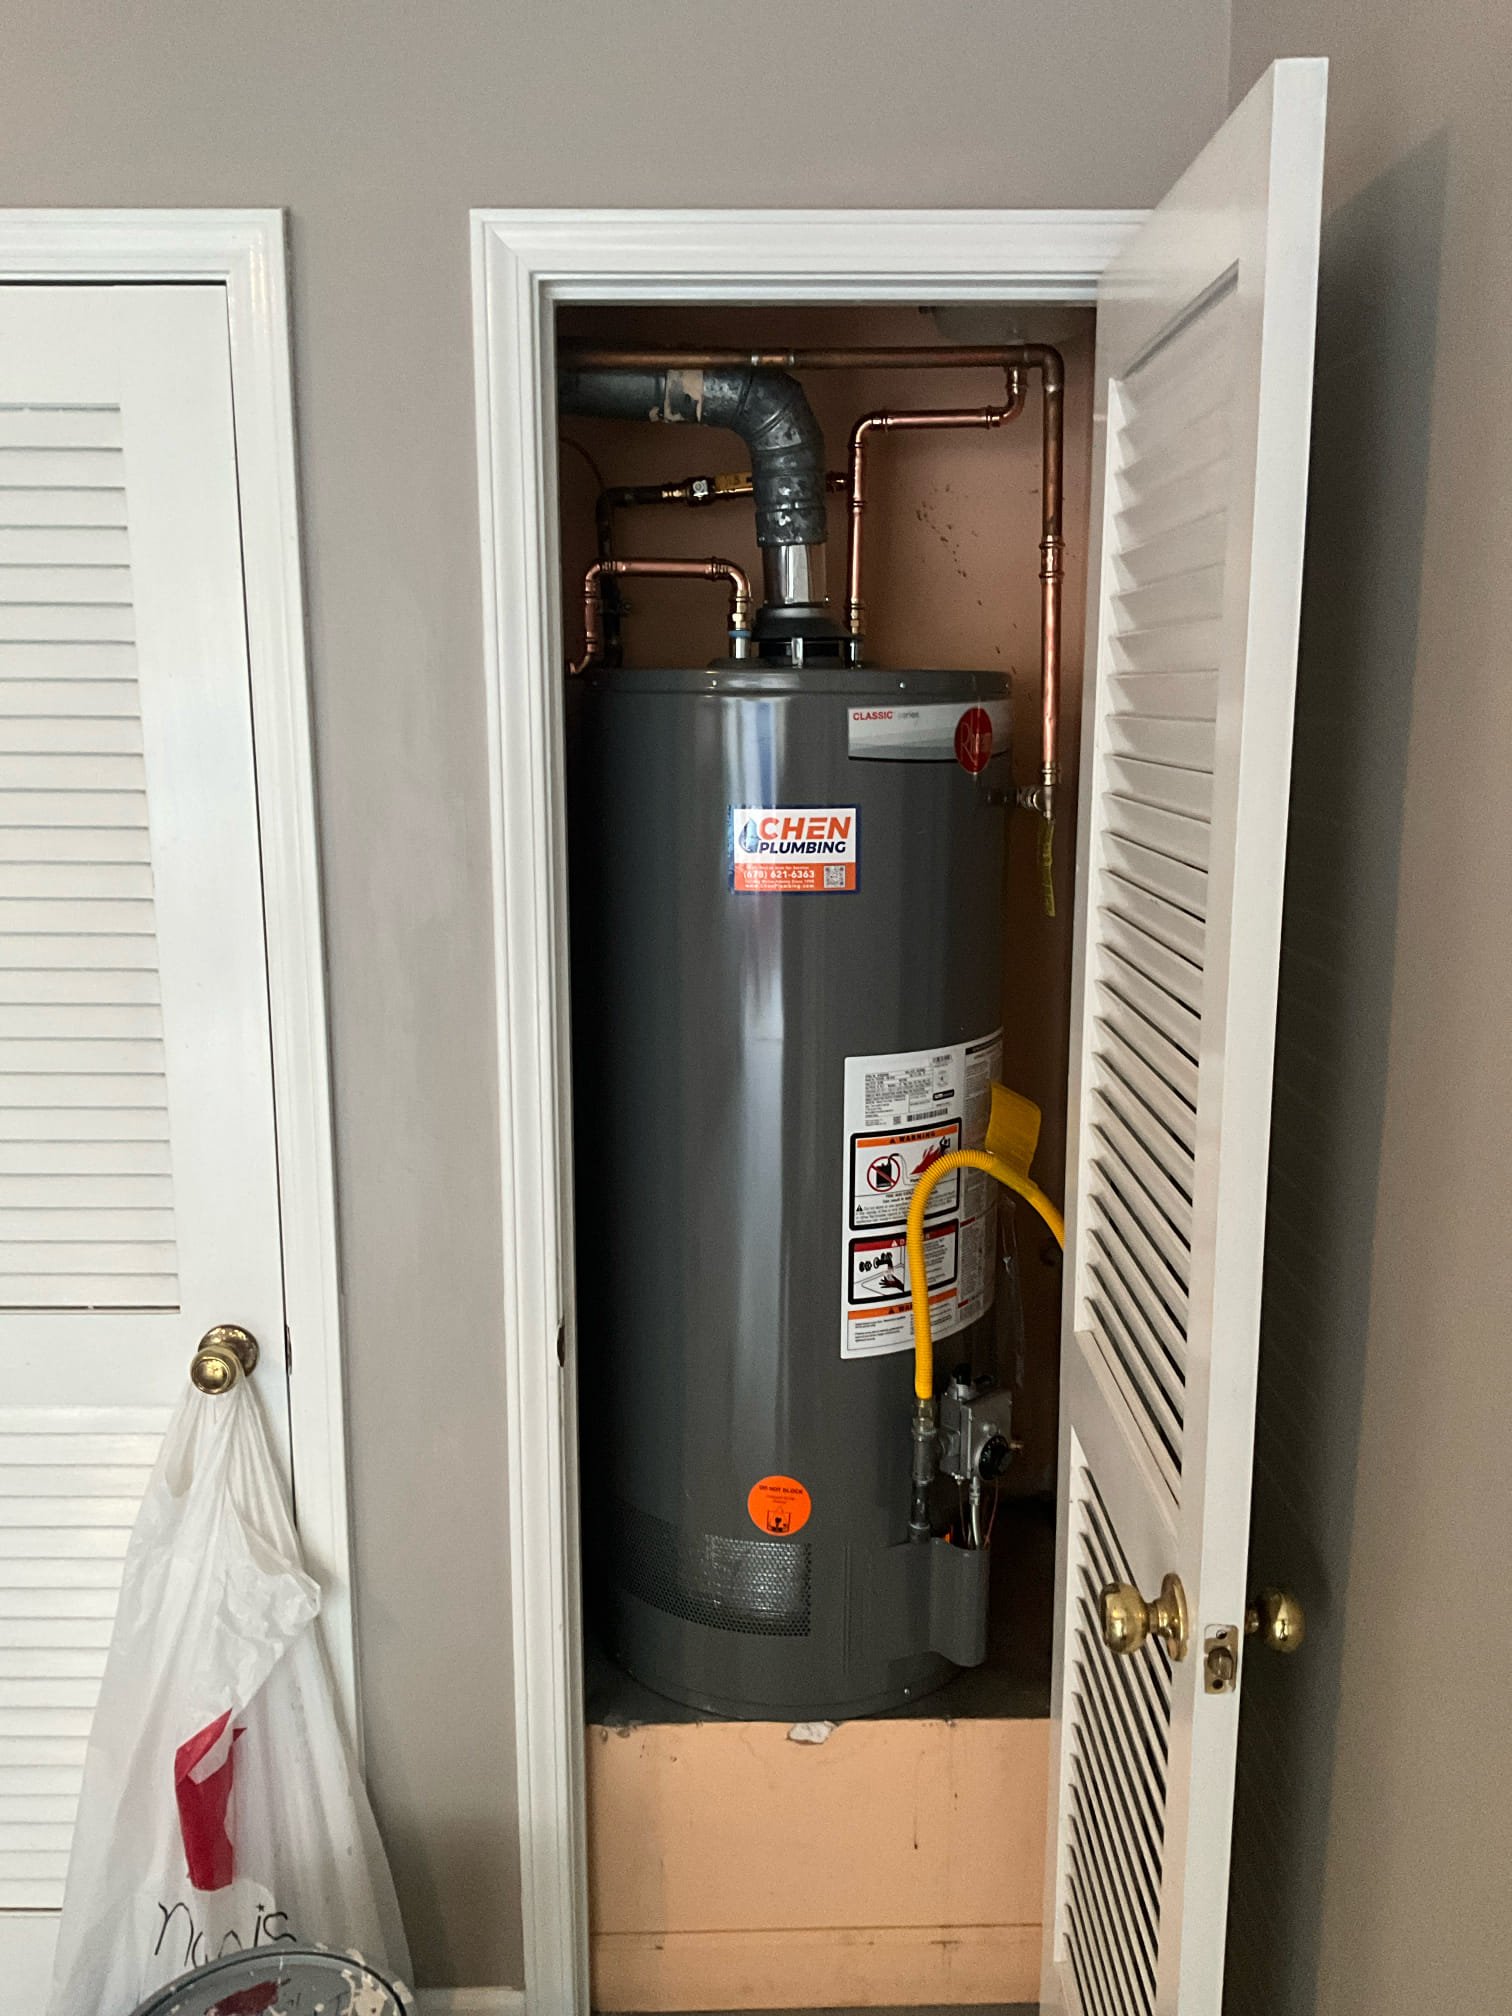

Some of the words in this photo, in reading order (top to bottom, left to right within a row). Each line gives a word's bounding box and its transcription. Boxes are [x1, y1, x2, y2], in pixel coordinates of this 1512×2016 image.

[853, 711, 893, 720] CLASSIC
[759, 816, 851, 840] CHEN
[760, 841, 846, 854] PLUMBING
[770, 870, 815, 878] 621-6363
[899, 1130, 937, 1143] WARNING
